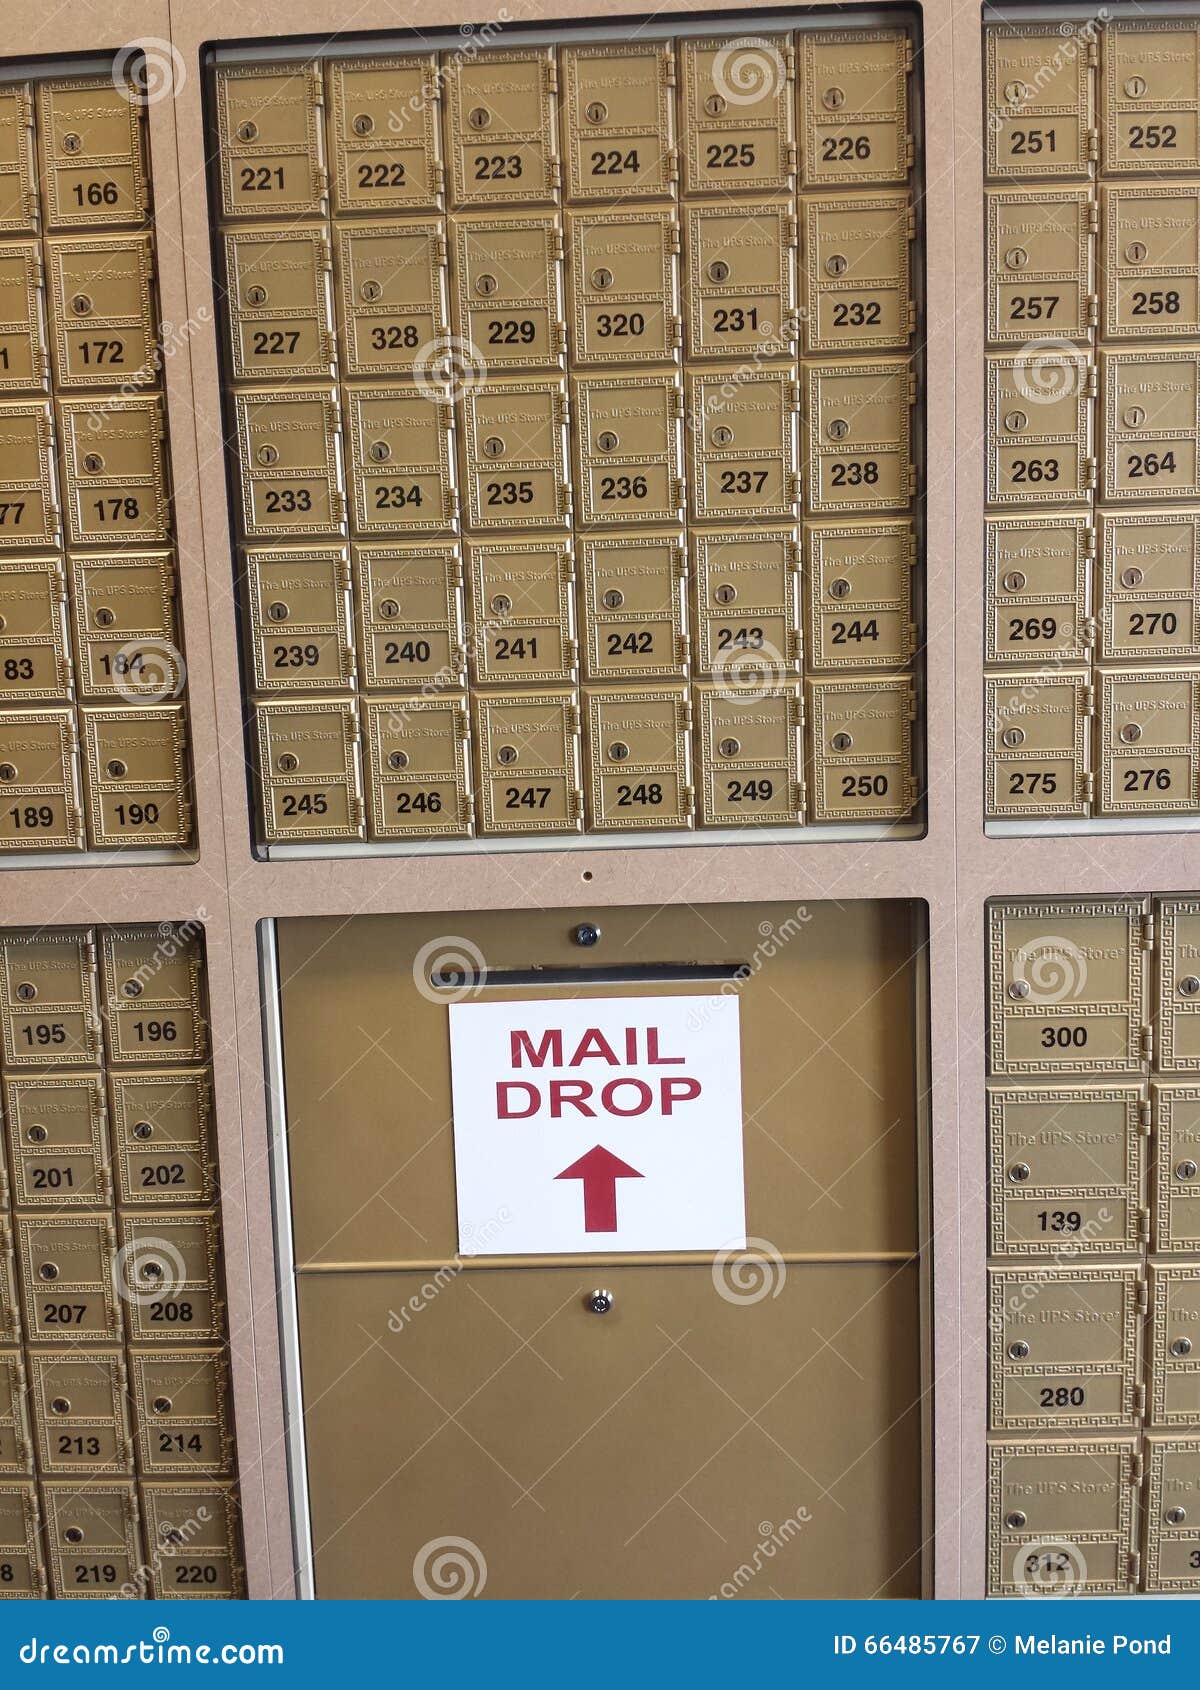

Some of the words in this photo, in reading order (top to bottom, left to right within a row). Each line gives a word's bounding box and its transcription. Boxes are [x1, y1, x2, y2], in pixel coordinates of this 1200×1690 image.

[1117, 52, 1137, 64] The
[1140, 52, 1158, 62] UPS
[52, 111, 72, 120] The
[74, 109, 93, 119] UPS
[1011, 130, 1055, 154] 251
[1129, 126, 1176, 148] 252
[707, 144, 754, 168] 225
[823, 137, 870, 161] 226
[475, 156, 522, 179] 223
[591, 151, 640, 175] 224
[241, 167, 284, 190] 221
[358, 164, 405, 187] 222
[73, 182, 118, 206] 166
[1119, 219, 1138, 230] The
[1140, 218, 1161, 229] UPS
[1011, 297, 1059, 319] 257
[1132, 291, 1179, 314] 258
[714, 308, 757, 332] 231
[834, 302, 880, 326] 232
[489, 321, 535, 344] 229
[597, 314, 644, 337] 320
[254, 332, 300, 354] 227
[372, 326, 418, 350] 328
[79, 341, 123, 363] 172
[1117, 384, 1136, 394] The
[1140, 383, 1159, 392] UPS
[822, 398, 841, 407] The
[843, 396, 862, 405] UPS
[590, 410, 609, 420] The
[612, 408, 630, 418] UPS
[249, 423, 268, 432] The
[270, 422, 289, 432] UPS
[832, 462, 878, 486] 238
[1012, 459, 1058, 482] 263
[1128, 452, 1176, 477] 264
[601, 476, 647, 499] 236
[721, 471, 768, 493] 237
[266, 490, 311, 512] 233
[376, 486, 422, 508] 234
[487, 482, 533, 505] 235
[94, 498, 139, 521] 178
[998, 550, 1017, 560] The
[1020, 549, 1040, 558] UPS
[1115, 546, 1133, 556] The
[1138, 545, 1158, 554] UPS
[823, 558, 841, 567] The
[844, 556, 865, 566] UPS
[597, 570, 613, 579] The
[617, 568, 637, 577] UPS
[85, 587, 105, 597] The
[108, 586, 126, 595] UPS
[260, 580, 279, 590] The
[282, 579, 301, 589] UPS
[832, 620, 879, 644] 244
[1009, 618, 1056, 640] 269
[1130, 613, 1176, 635] 270
[495, 638, 536, 659] 241
[608, 632, 653, 655] 242
[718, 628, 762, 650] 243
[274, 645, 319, 667] 239
[385, 641, 430, 663] 240
[100, 652, 146, 676] 184
[824, 711, 842, 720] The
[845, 710, 865, 720] UPS
[1113, 704, 1132, 713] The
[1136, 702, 1155, 712] UPS
[489, 726, 509, 735] The
[511, 724, 531, 734] UPS
[713, 716, 731, 726] The
[734, 716, 753, 726] UPS
[728, 780, 772, 801] 249
[842, 775, 887, 796] 250
[1010, 773, 1056, 793] 275
[1124, 769, 1170, 791] 276
[283, 794, 327, 816] 245
[397, 792, 441, 813] 246
[506, 788, 551, 808] 247
[618, 784, 662, 806] 248
[10, 807, 53, 828] 189
[115, 804, 158, 825] 190
[1008, 948, 1035, 961] The
[1040, 947, 1073, 961] UPS
[9, 962, 27, 971] The
[30, 960, 49, 970] UPS
[23, 1024, 65, 1045] 195
[134, 1021, 176, 1041] 196
[1042, 1027, 1087, 1047] 300
[510, 1027, 686, 1069] MAIL
[496, 1077, 702, 1120] DROP
[1007, 1132, 1037, 1146] The
[1040, 1132, 1072, 1145] UPS
[33, 1168, 73, 1188] 201
[141, 1165, 185, 1186] 202
[1038, 1212, 1080, 1231] 139
[44, 1304, 86, 1323] 207
[151, 1303, 192, 1321] 208
[1007, 1312, 1035, 1324] The
[1040, 1310, 1071, 1323] UPS
[1040, 1387, 1084, 1407] 280
[59, 1436, 100, 1455] 213
[160, 1434, 202, 1452] 214
[1006, 1484, 1033, 1496] The
[1036, 1482, 1067, 1494] UPS
[1027, 1553, 1069, 1572] 312
[76, 1565, 116, 1583] 219
[176, 1566, 217, 1583] 220
